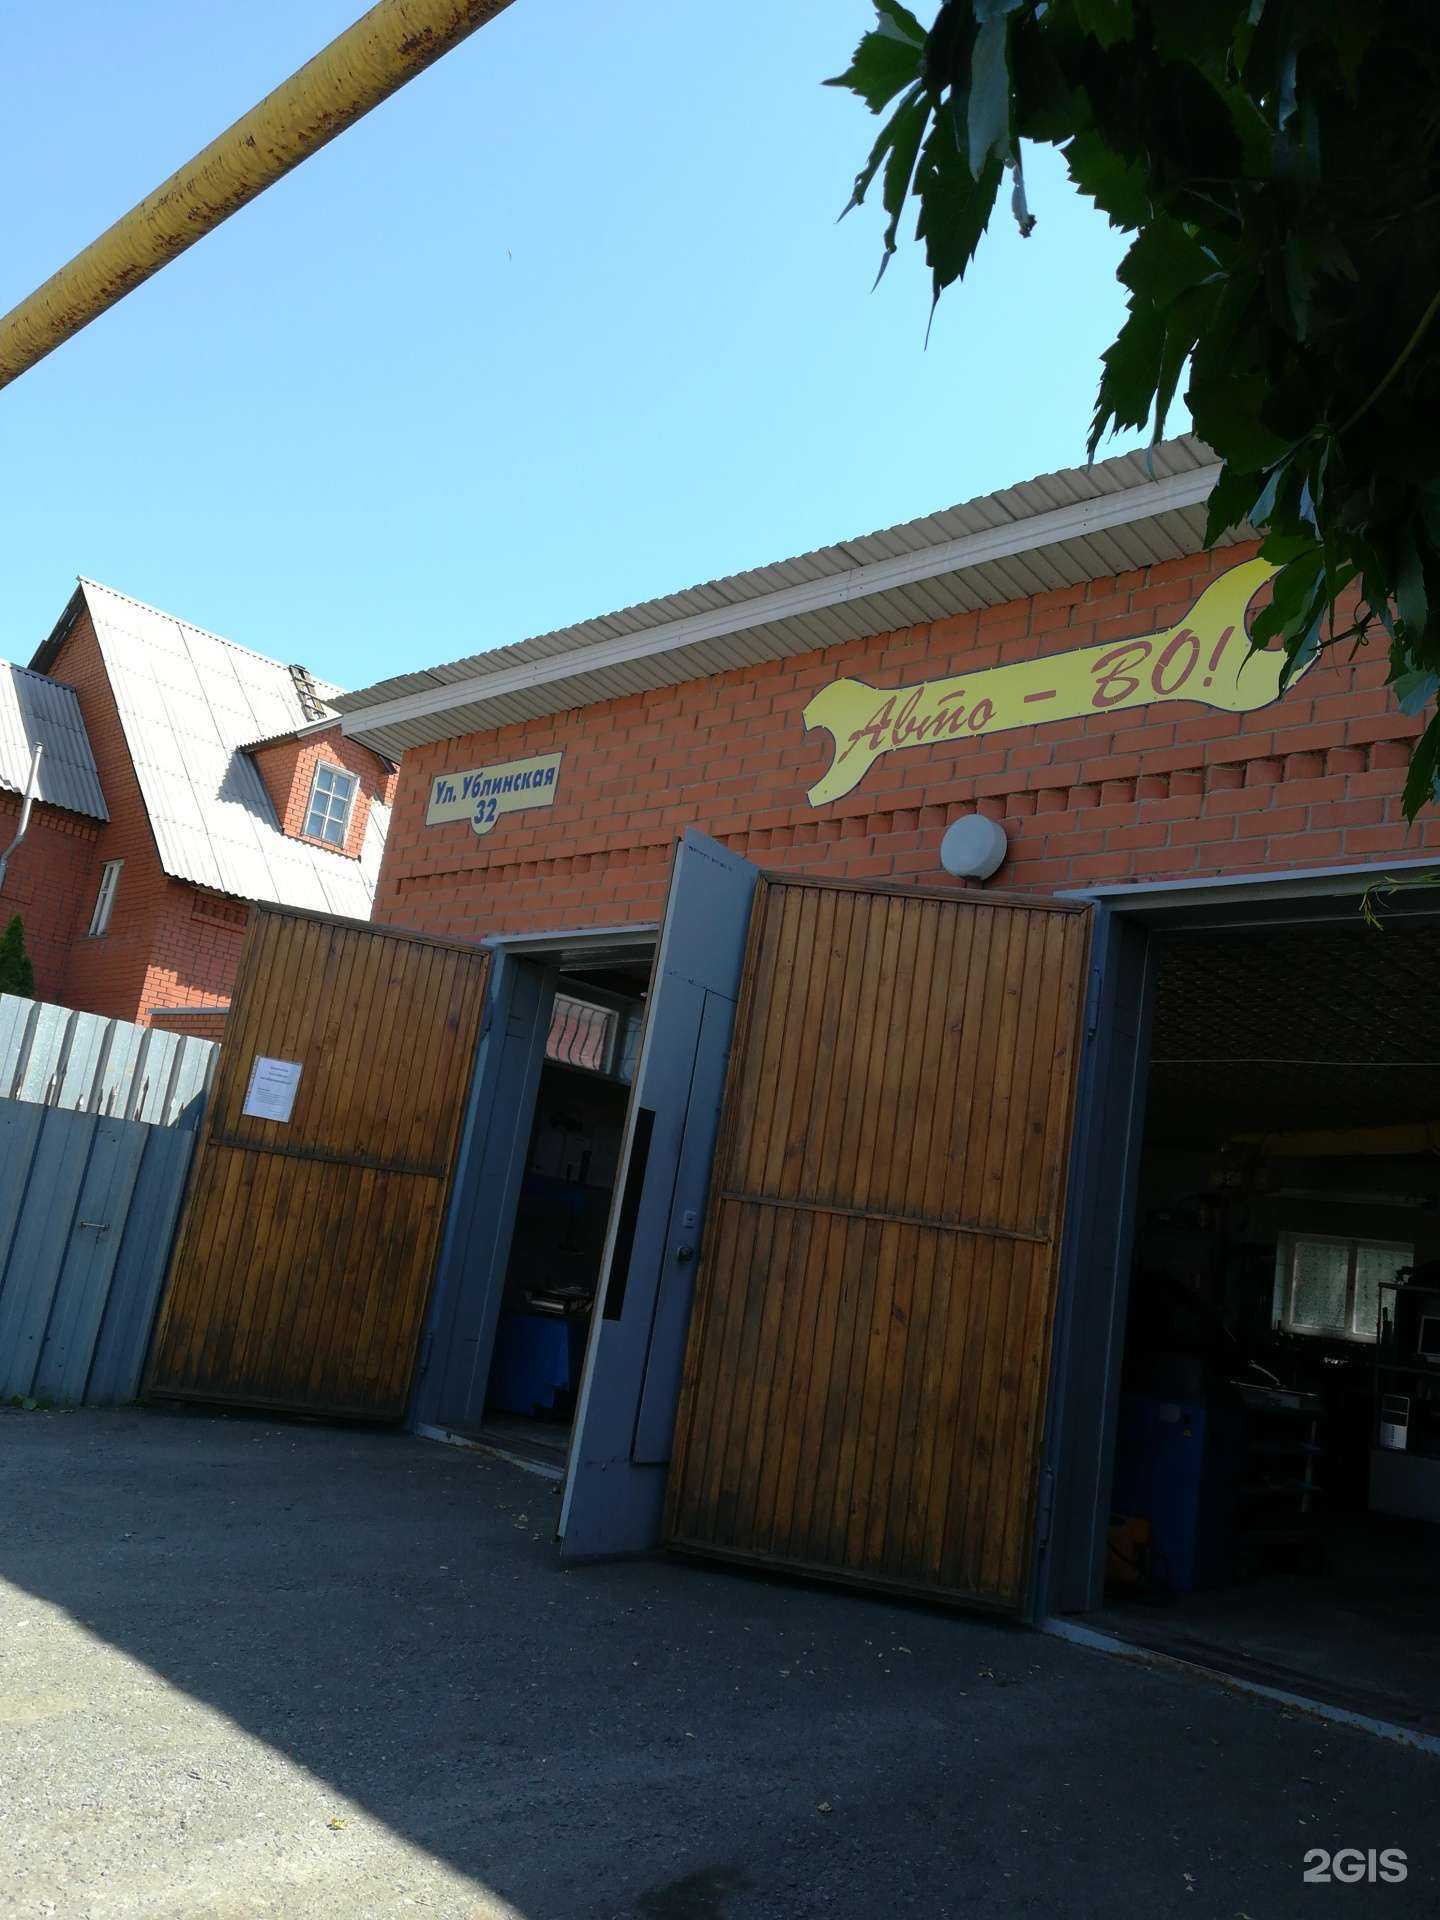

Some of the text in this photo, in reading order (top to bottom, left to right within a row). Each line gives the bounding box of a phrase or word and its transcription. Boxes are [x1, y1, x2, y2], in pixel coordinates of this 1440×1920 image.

[837, 686, 997, 764] Авто
[1090, 626, 1236, 708] ВО!
[435, 767, 556, 805] Ул. Ублинская
[473, 798, 498, 824] 32
